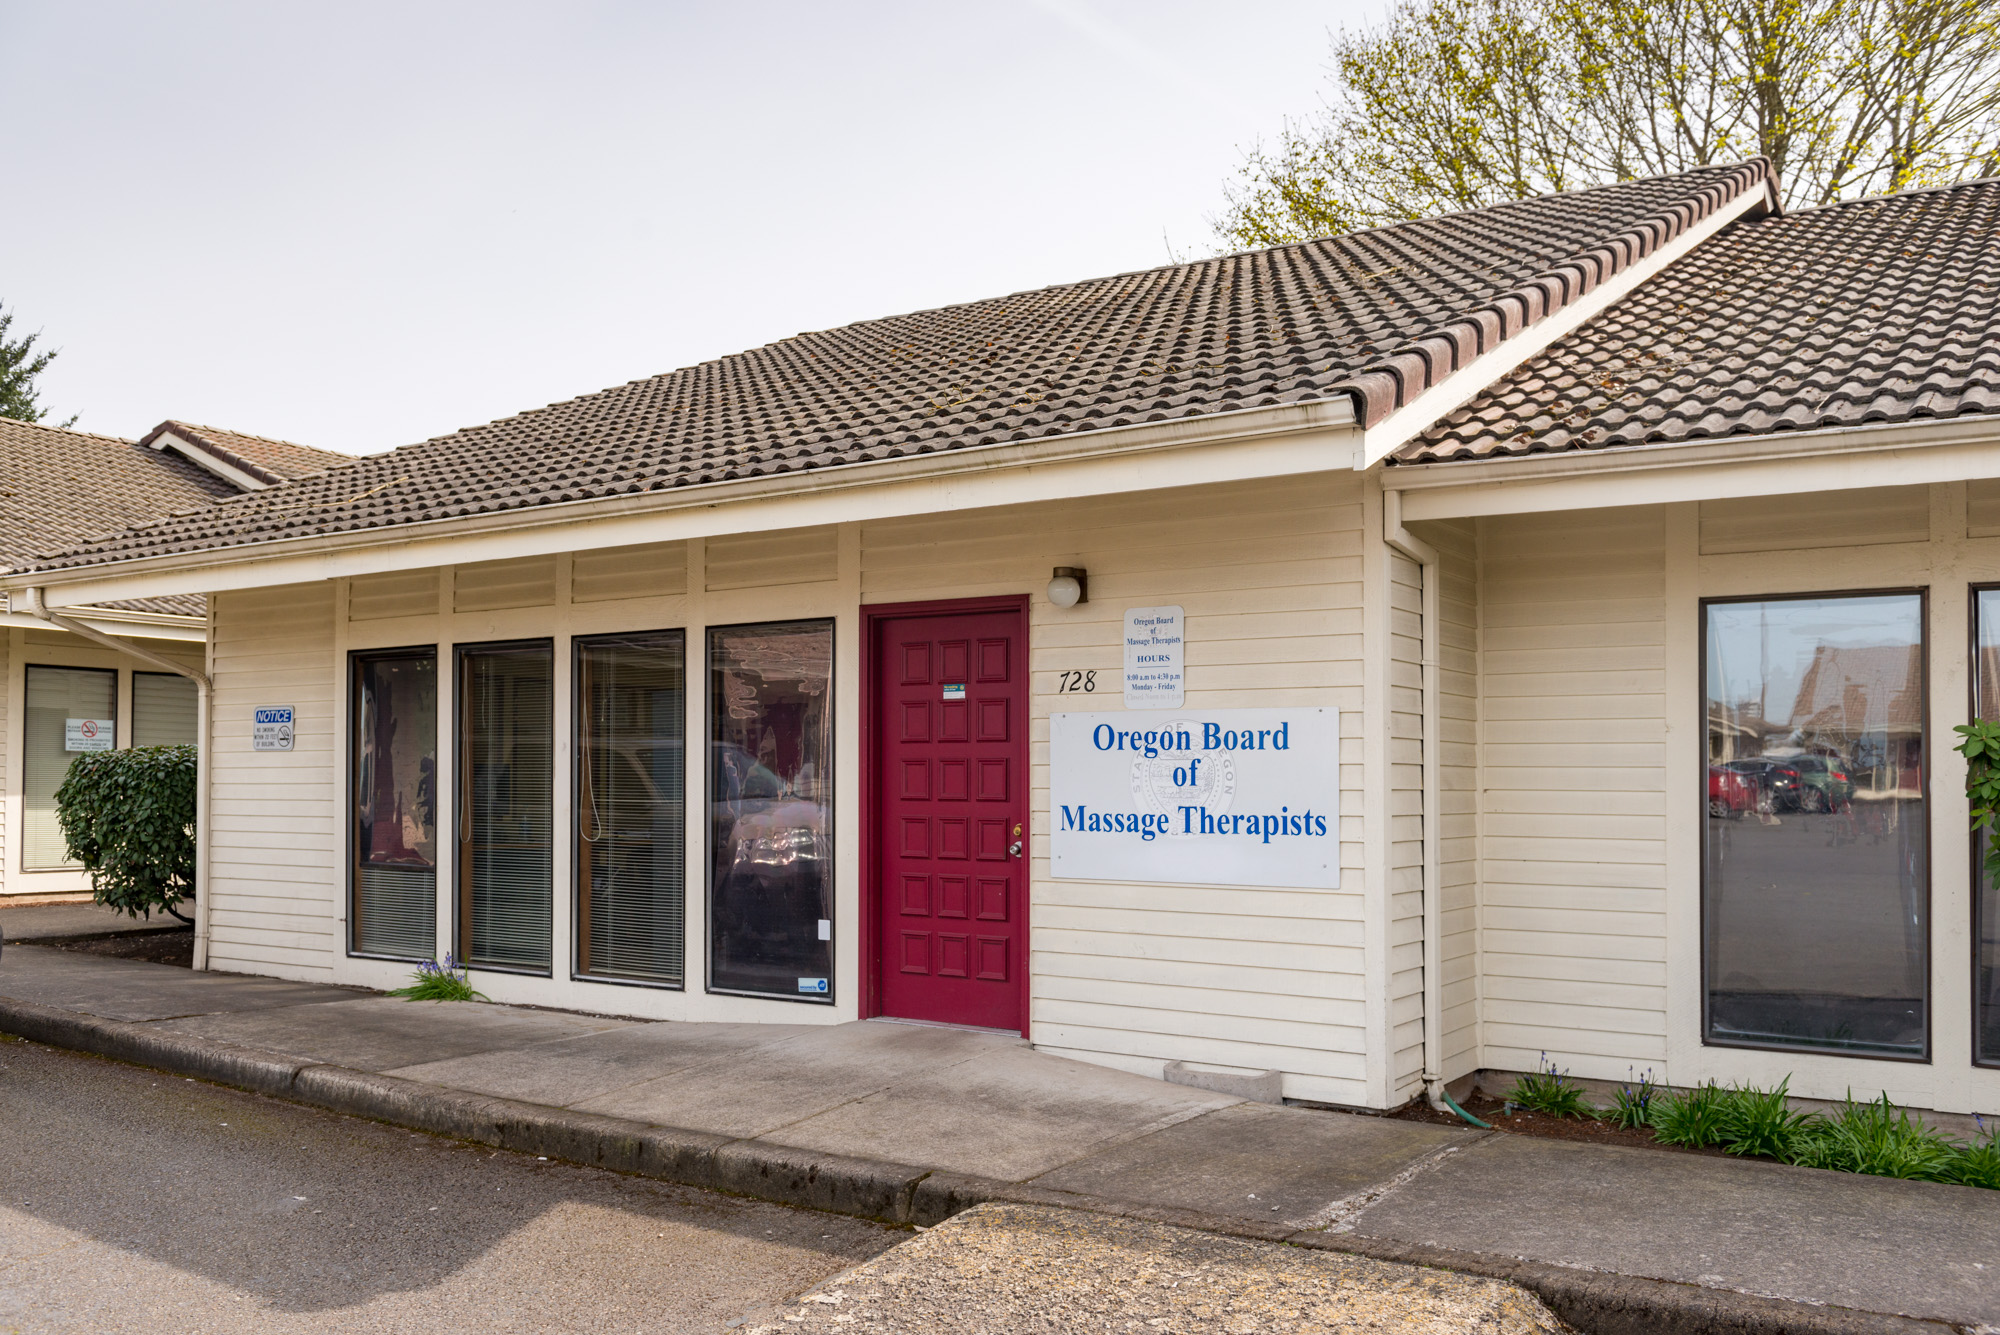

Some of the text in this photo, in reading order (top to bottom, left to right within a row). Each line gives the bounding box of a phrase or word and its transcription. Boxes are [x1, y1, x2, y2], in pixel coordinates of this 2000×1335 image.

[1133, 616, 1174, 627] Oregon Board
[1150, 627, 1157, 635] of
[1127, 636, 1181, 646] Massage Therapists
[1137, 654, 1171, 663] HOURS
[1059, 670, 1097, 693] 728
[1131, 683, 1153, 692] Monday
[1158, 683, 1176, 691] Friday
[256, 710, 290, 722] NOTICE
[1092, 721, 1290, 759] Oregon Board
[1172, 758, 1202, 787] of
[1060, 804, 1327, 844] Massage Therapists
